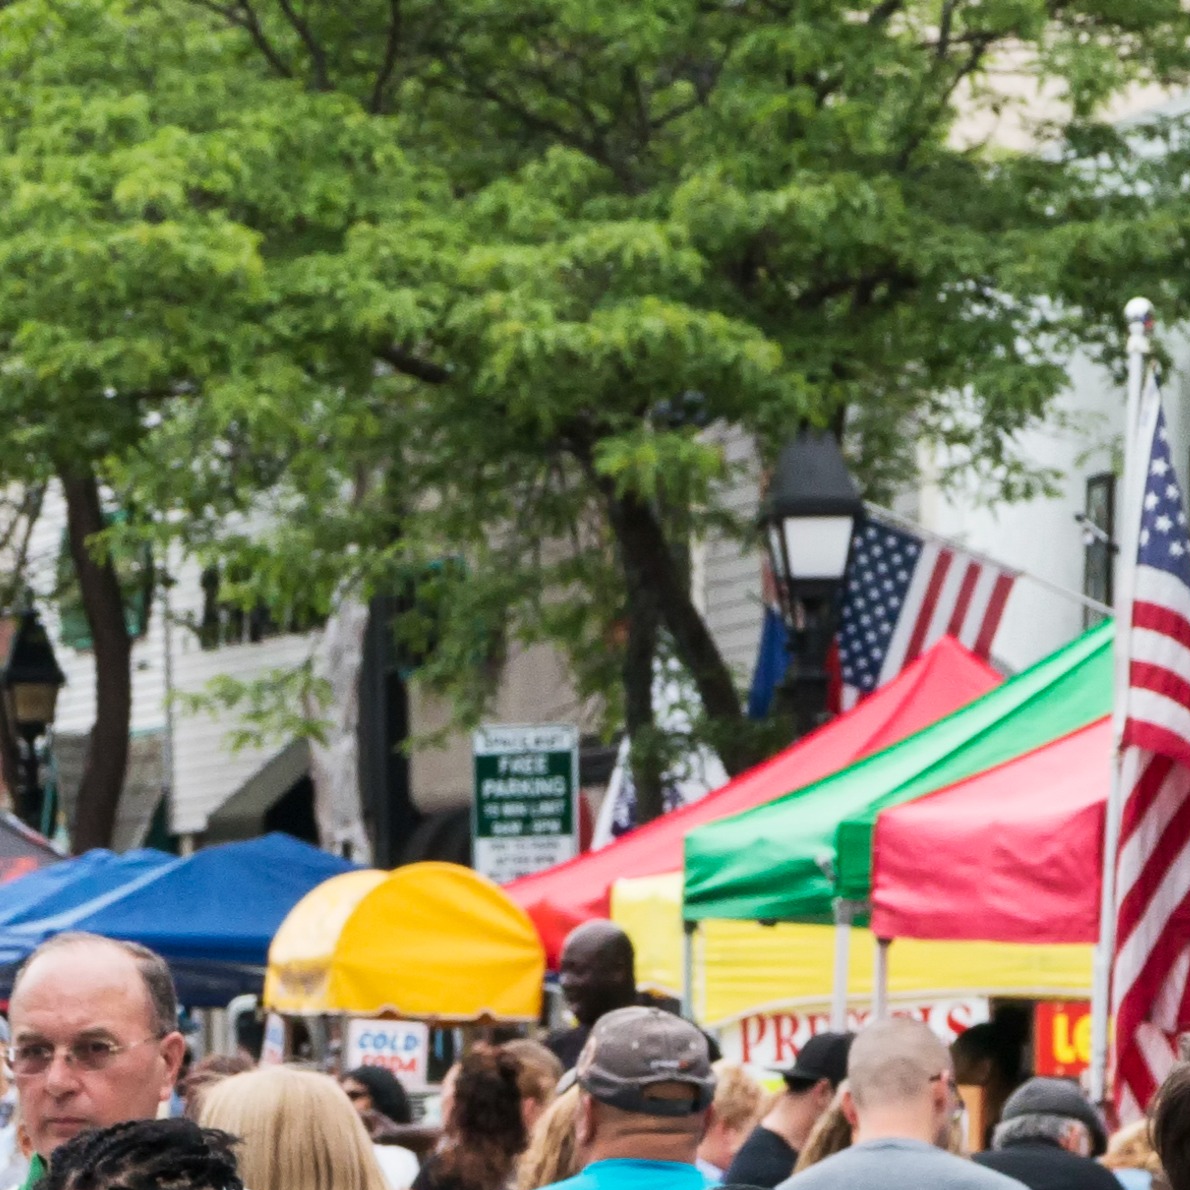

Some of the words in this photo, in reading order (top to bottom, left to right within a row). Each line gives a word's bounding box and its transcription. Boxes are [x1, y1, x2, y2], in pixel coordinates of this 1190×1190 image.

[497, 754, 549, 776] FREE
[481, 776, 566, 799] PARKING
[358, 1032, 419, 1051] COLD
